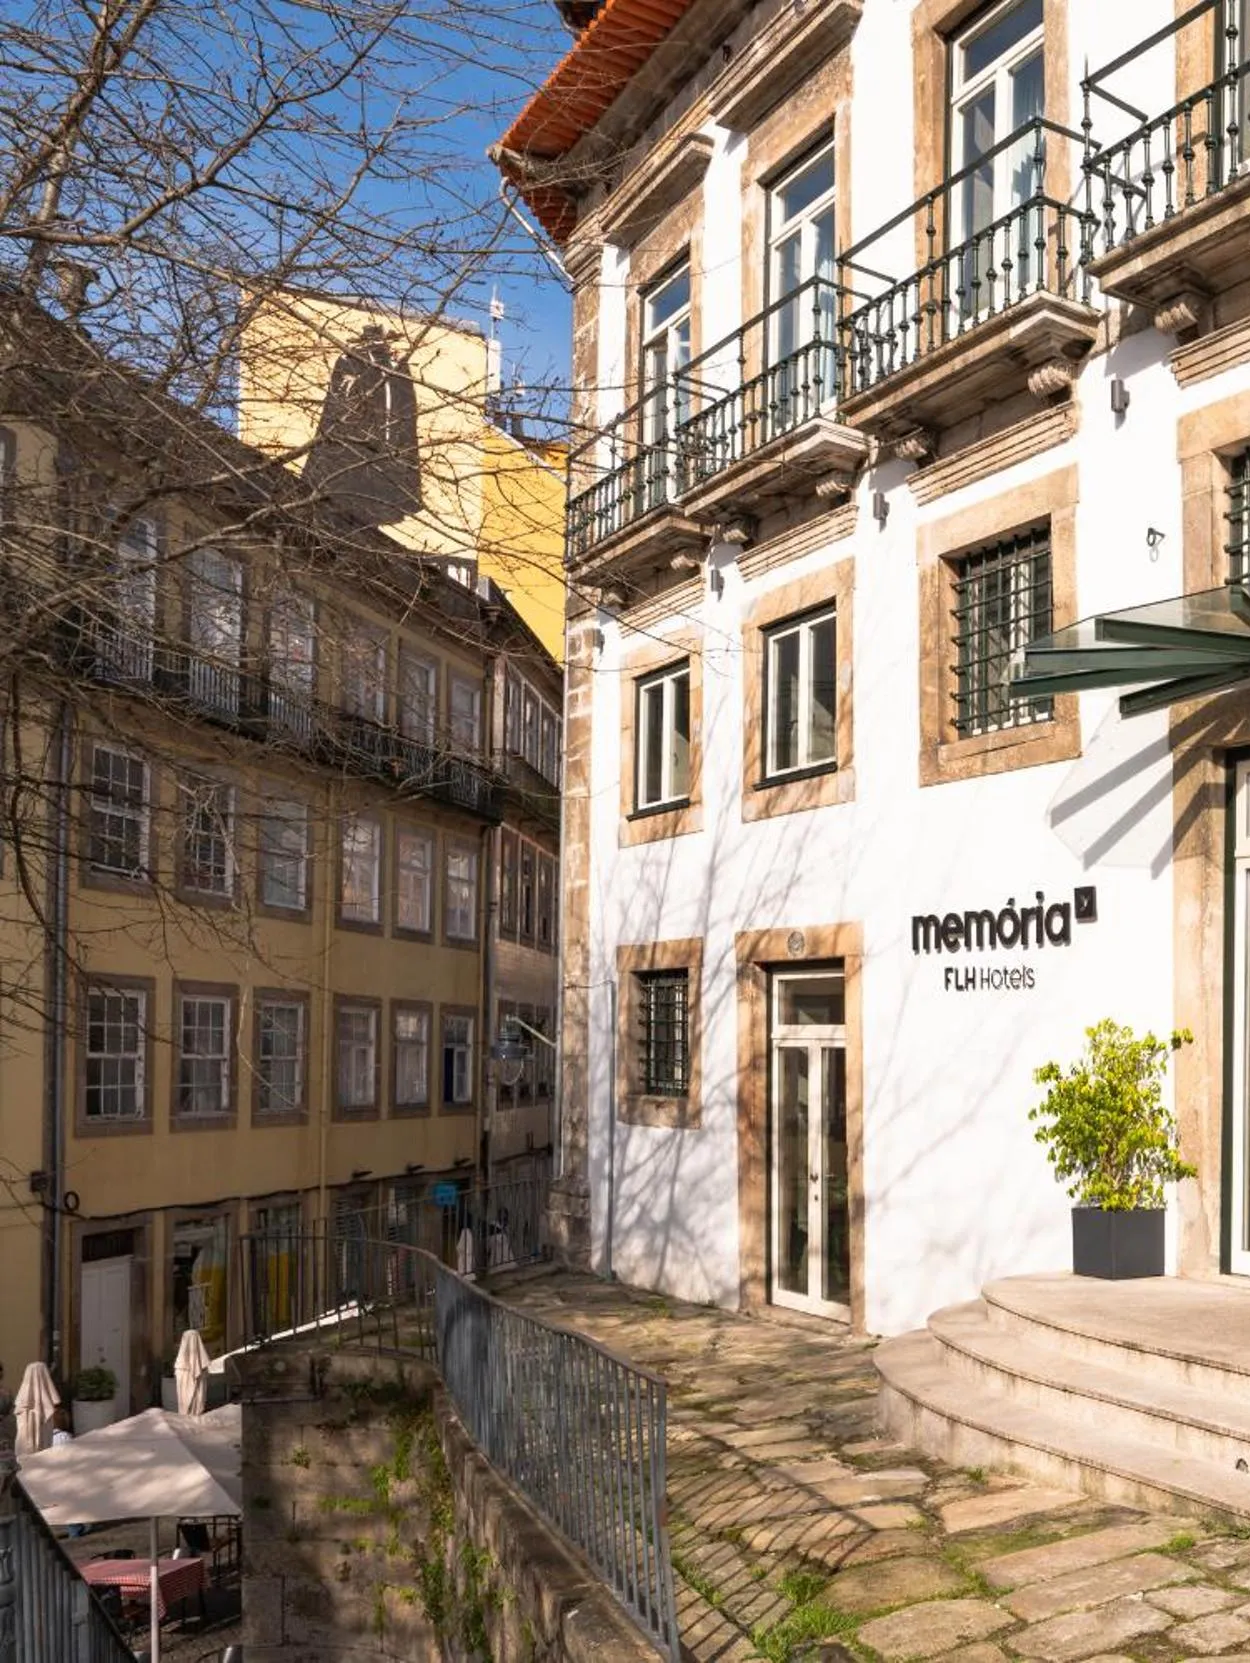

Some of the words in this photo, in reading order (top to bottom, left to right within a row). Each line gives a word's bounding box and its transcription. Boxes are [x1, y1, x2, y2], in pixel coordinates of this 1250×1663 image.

[912, 890, 1071, 954] memória
[944, 967, 976, 991] FLH
[980, 965, 1035, 990] Hotels
